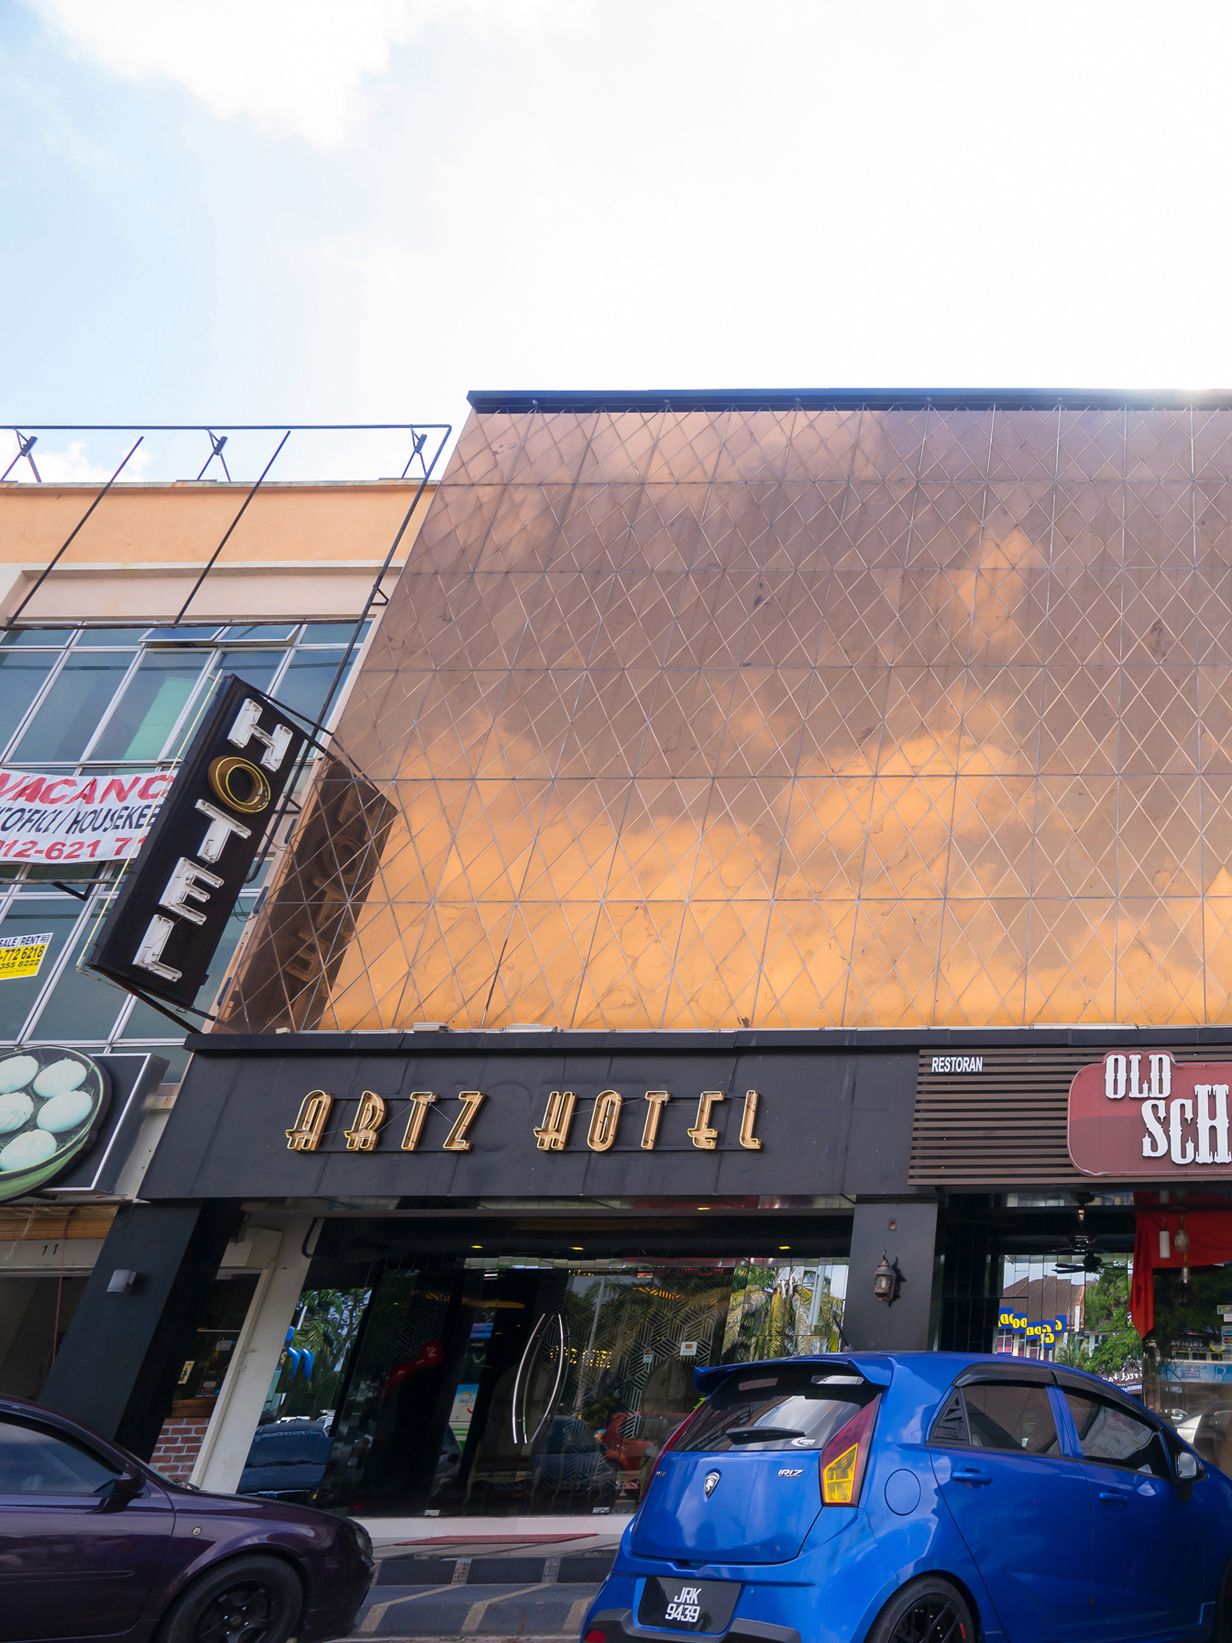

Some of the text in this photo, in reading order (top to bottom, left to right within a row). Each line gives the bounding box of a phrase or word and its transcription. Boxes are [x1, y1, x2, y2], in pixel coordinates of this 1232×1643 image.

[132, 698, 293, 982] HOTEL
[0, 840, 101, 861] 12-621
[931, 1056, 983, 1073] RESTORAN
[1104, 1054, 1172, 1099] OLD
[285, 1089, 764, 1153] ARTZ HOTEL
[777, 1468, 805, 1478] IRIZ
[674, 1586, 702, 1604] JRK
[665, 1603, 700, 1623] 9439
